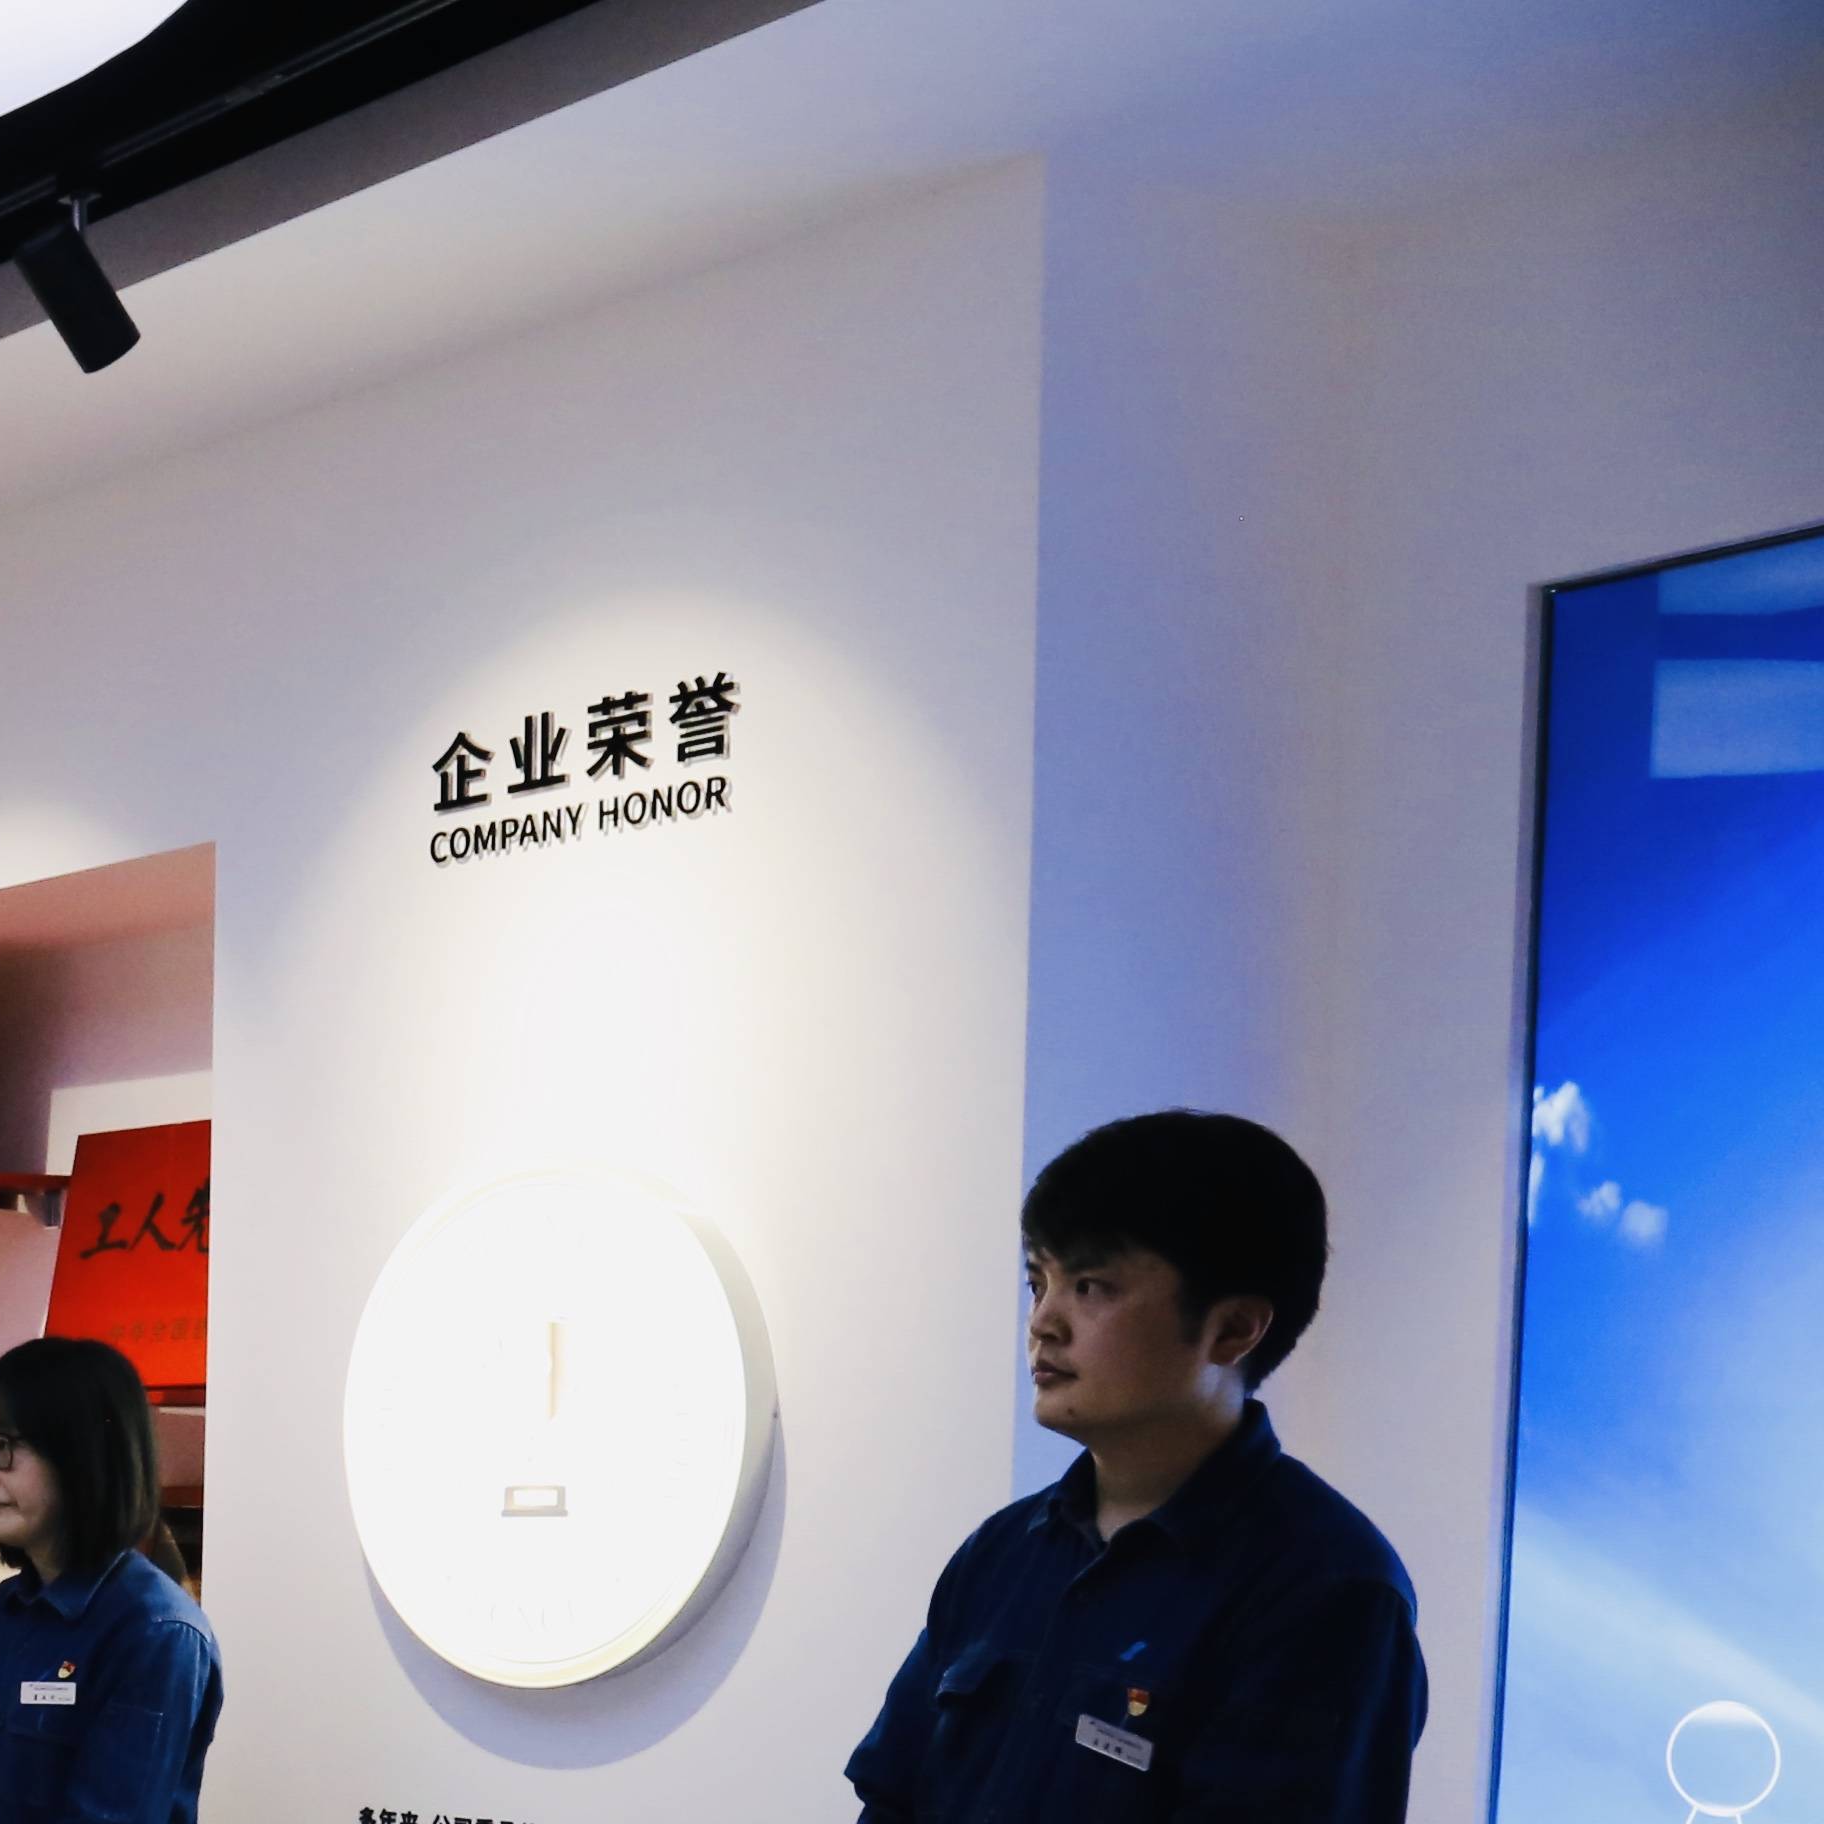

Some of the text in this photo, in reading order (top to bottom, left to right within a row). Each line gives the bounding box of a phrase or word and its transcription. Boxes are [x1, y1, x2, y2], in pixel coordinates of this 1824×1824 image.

[432, 672, 739, 812] 企业荣誉
[430, 776, 728, 863] COMPANY HONOR
